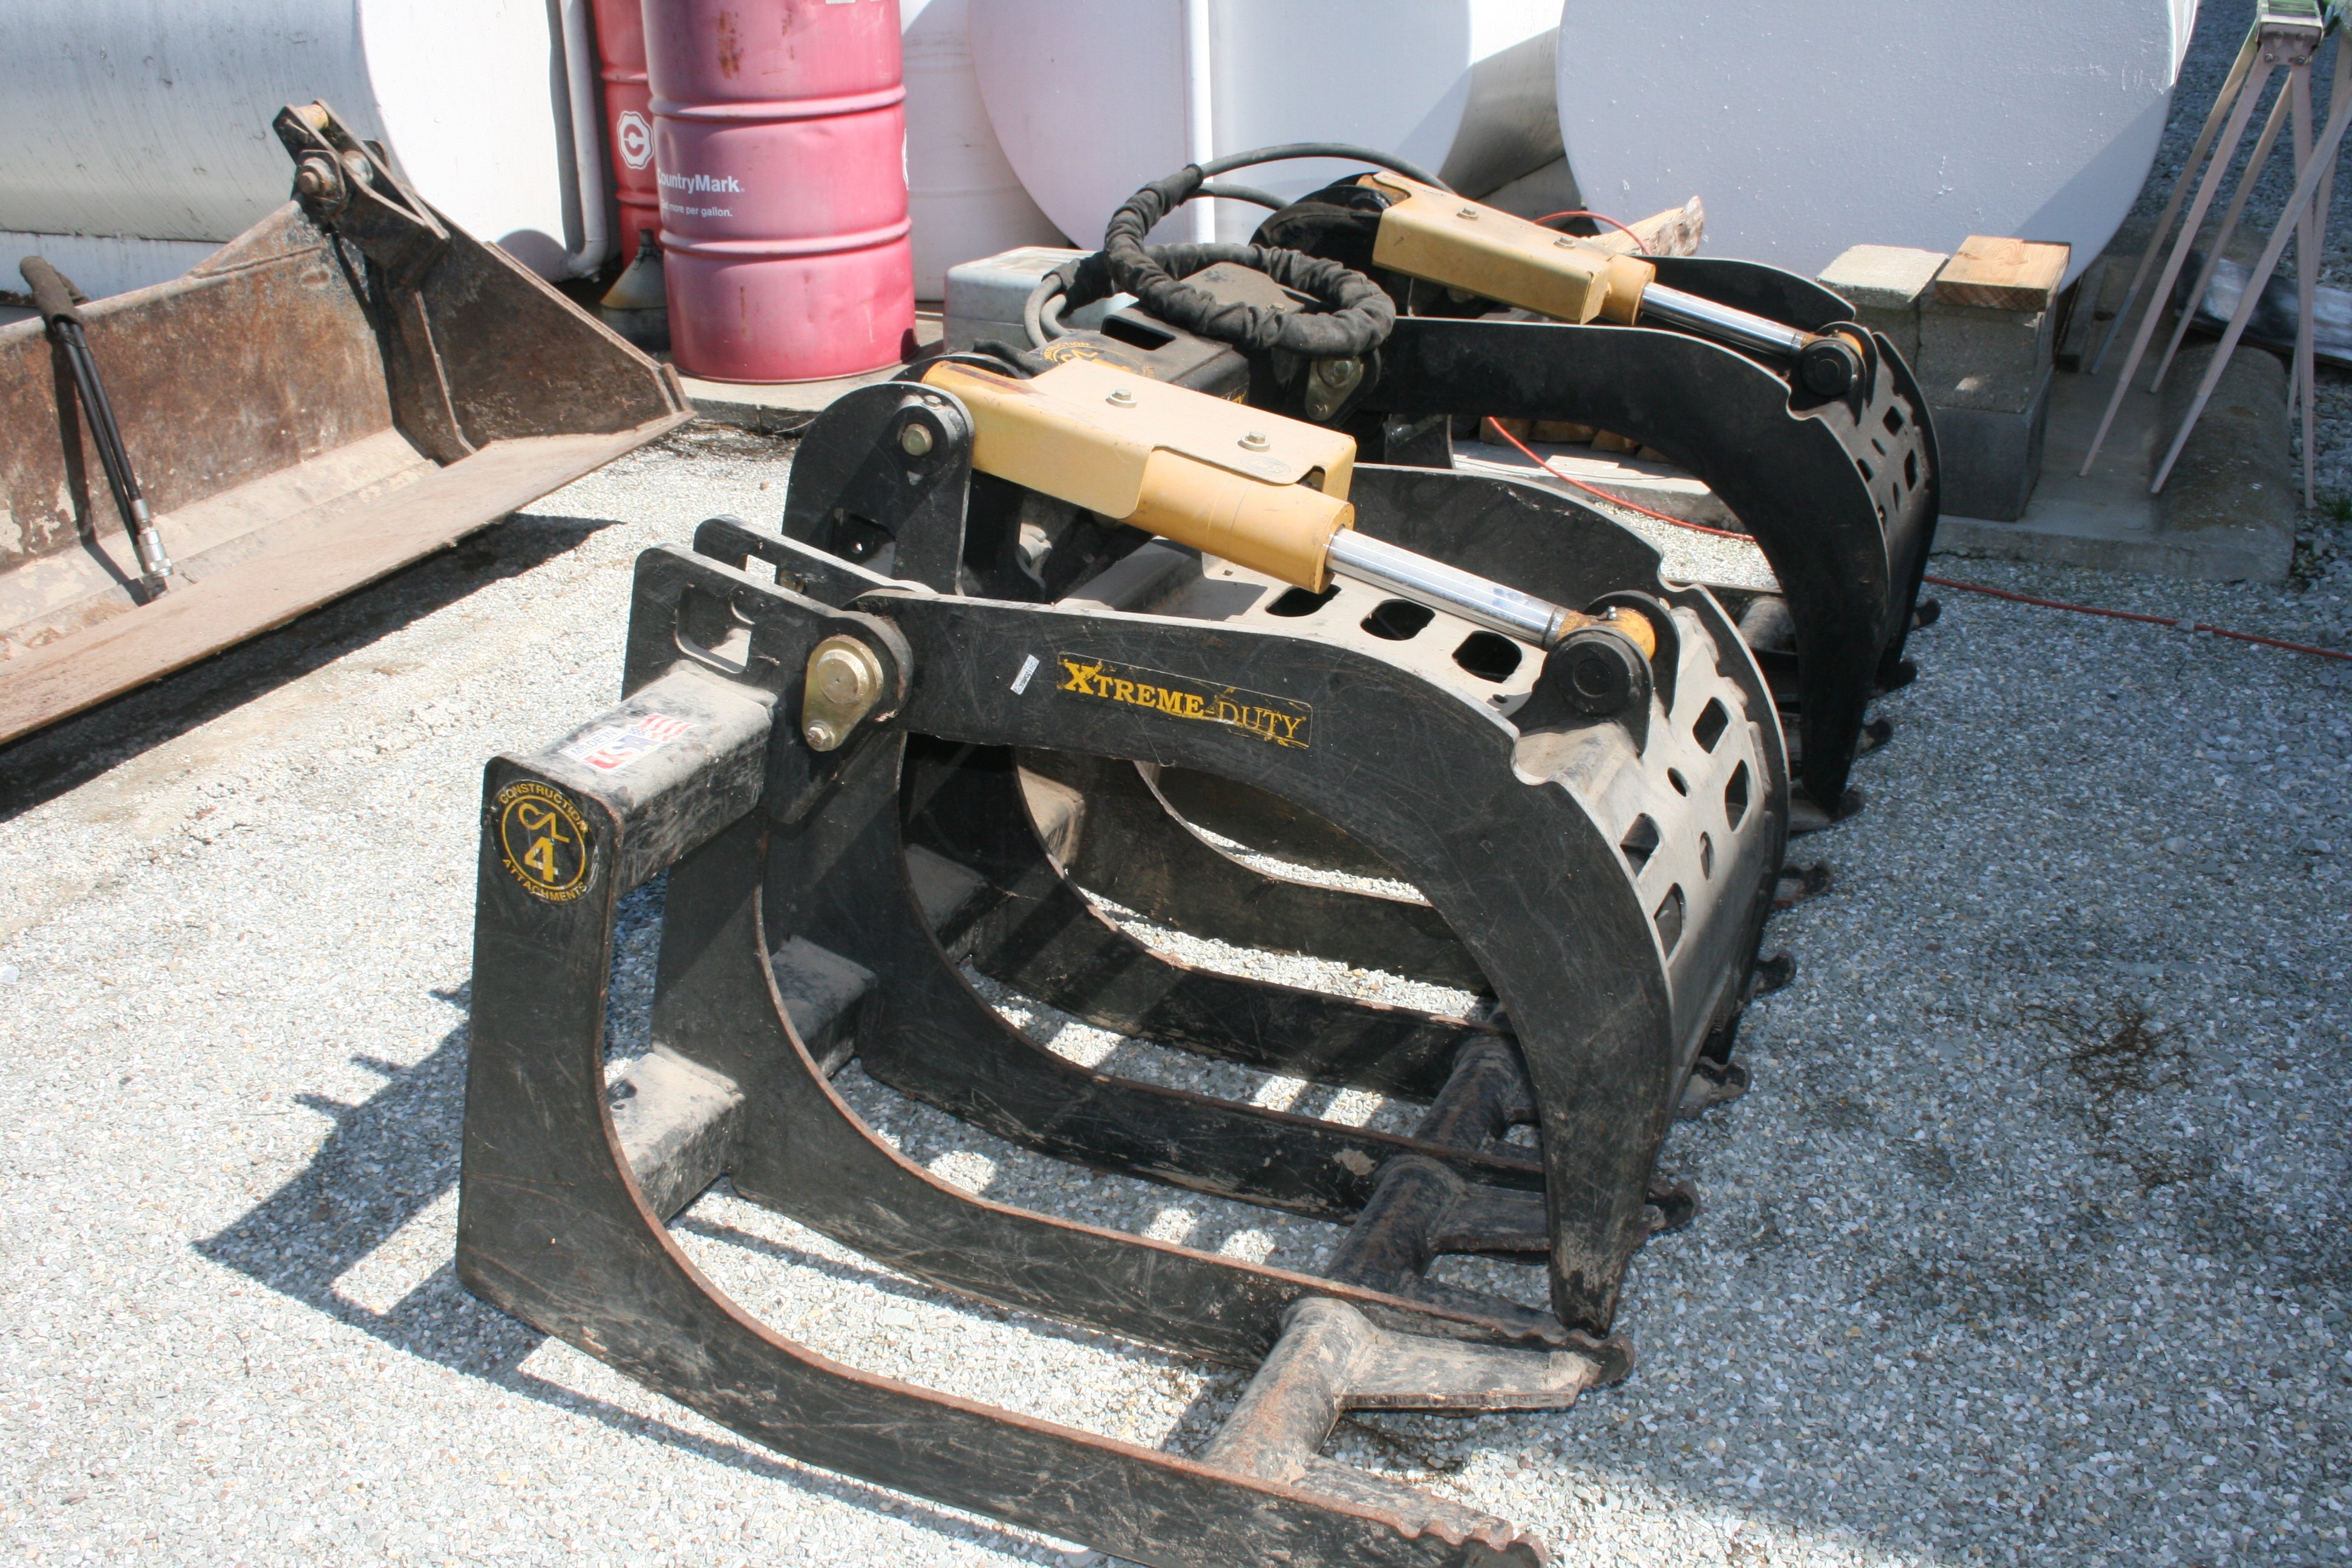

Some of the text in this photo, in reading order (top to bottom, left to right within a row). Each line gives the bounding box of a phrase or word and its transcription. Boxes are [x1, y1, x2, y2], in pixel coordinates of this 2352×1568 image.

[685, 207, 699, 215] per
[701, 206, 733, 218] gallon.
[570, 729, 619, 756] MADE IN
[583, 734, 661, 769] USA
[503, 858, 587, 901] ATTACHMENTS
